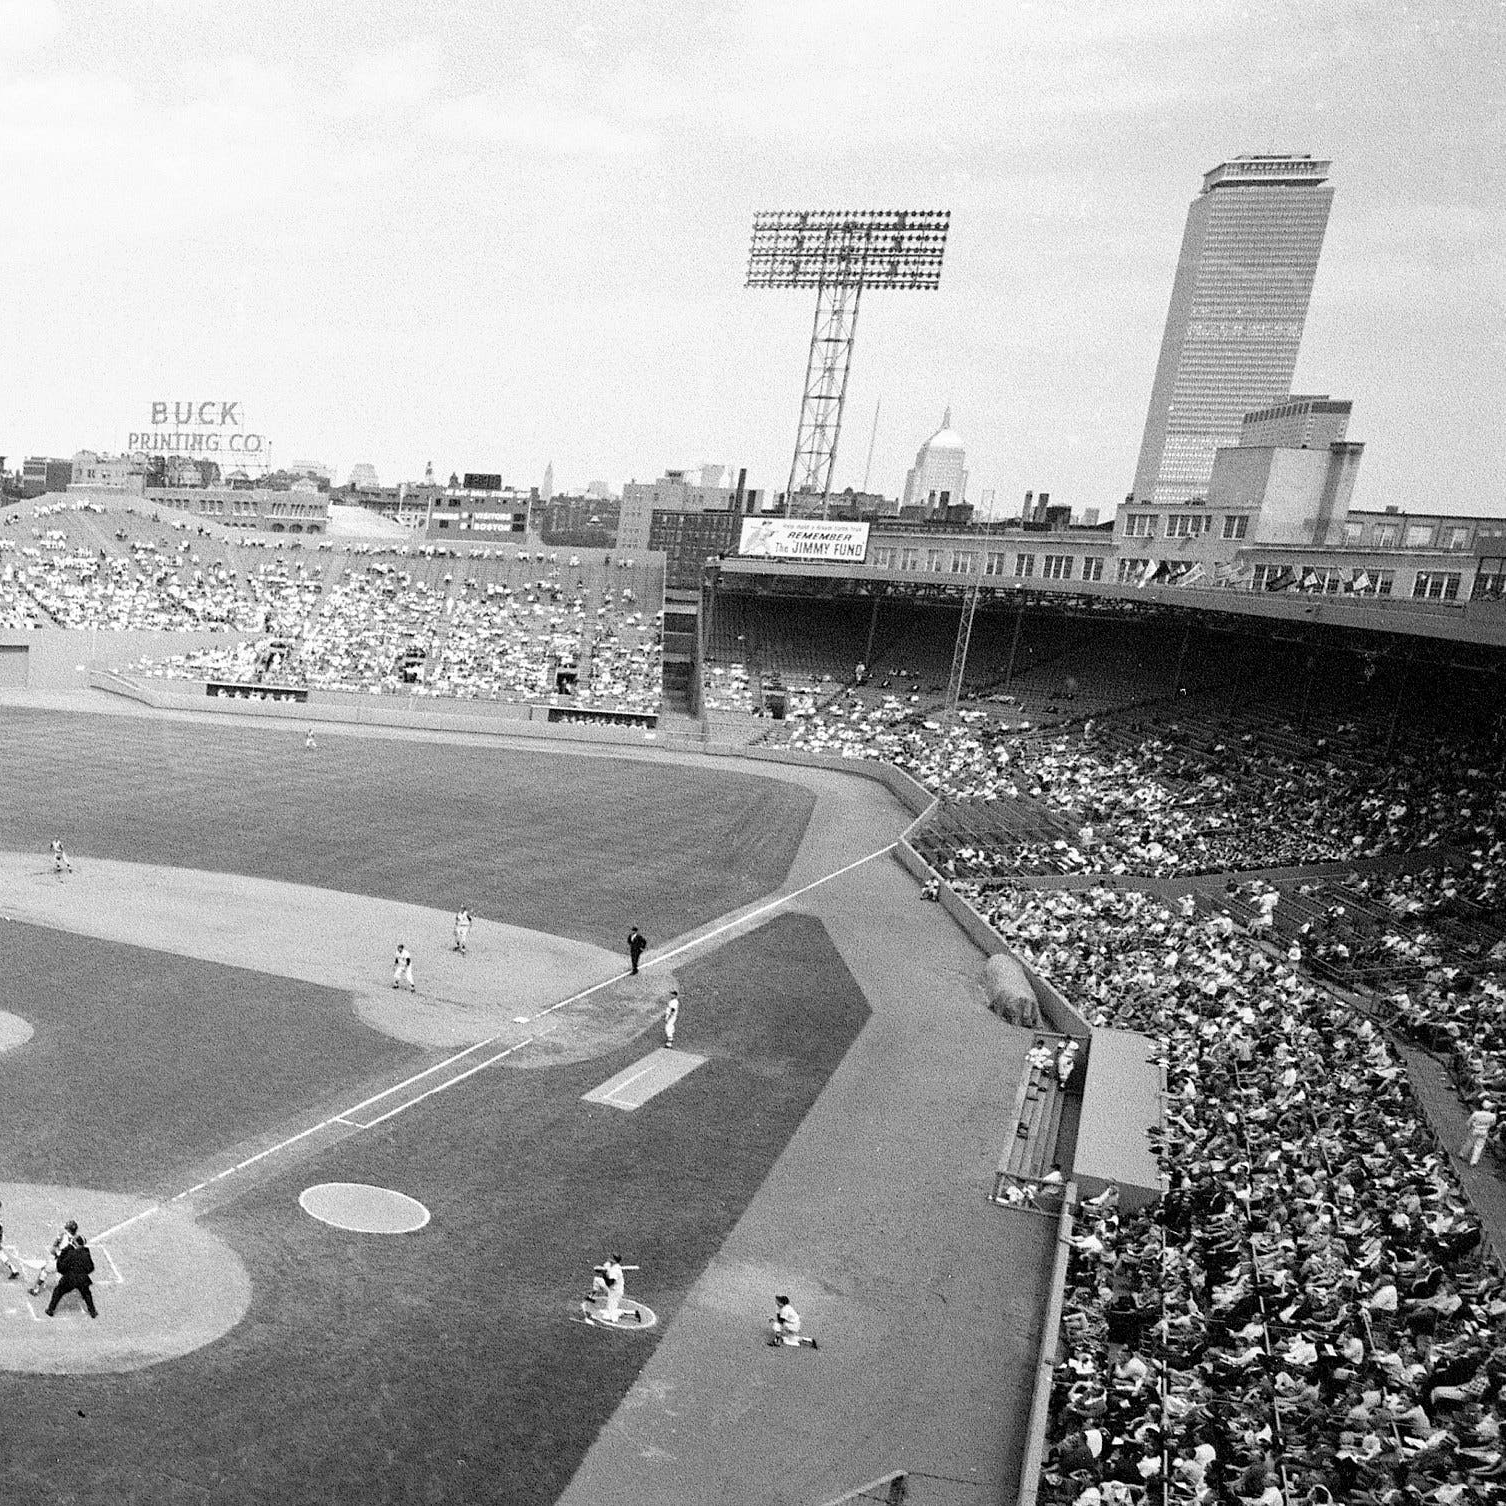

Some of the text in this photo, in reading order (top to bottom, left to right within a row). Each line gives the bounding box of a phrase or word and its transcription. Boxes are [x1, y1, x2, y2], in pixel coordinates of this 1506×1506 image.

[151, 402, 238, 425] BUCK
[129, 432, 219, 451] PRINTING
[474, 512, 512, 520] VISITORS
[474, 522, 511, 531] BOSTON
[787, 531, 852, 541] REMEMBER
[775, 542, 789, 553] The
